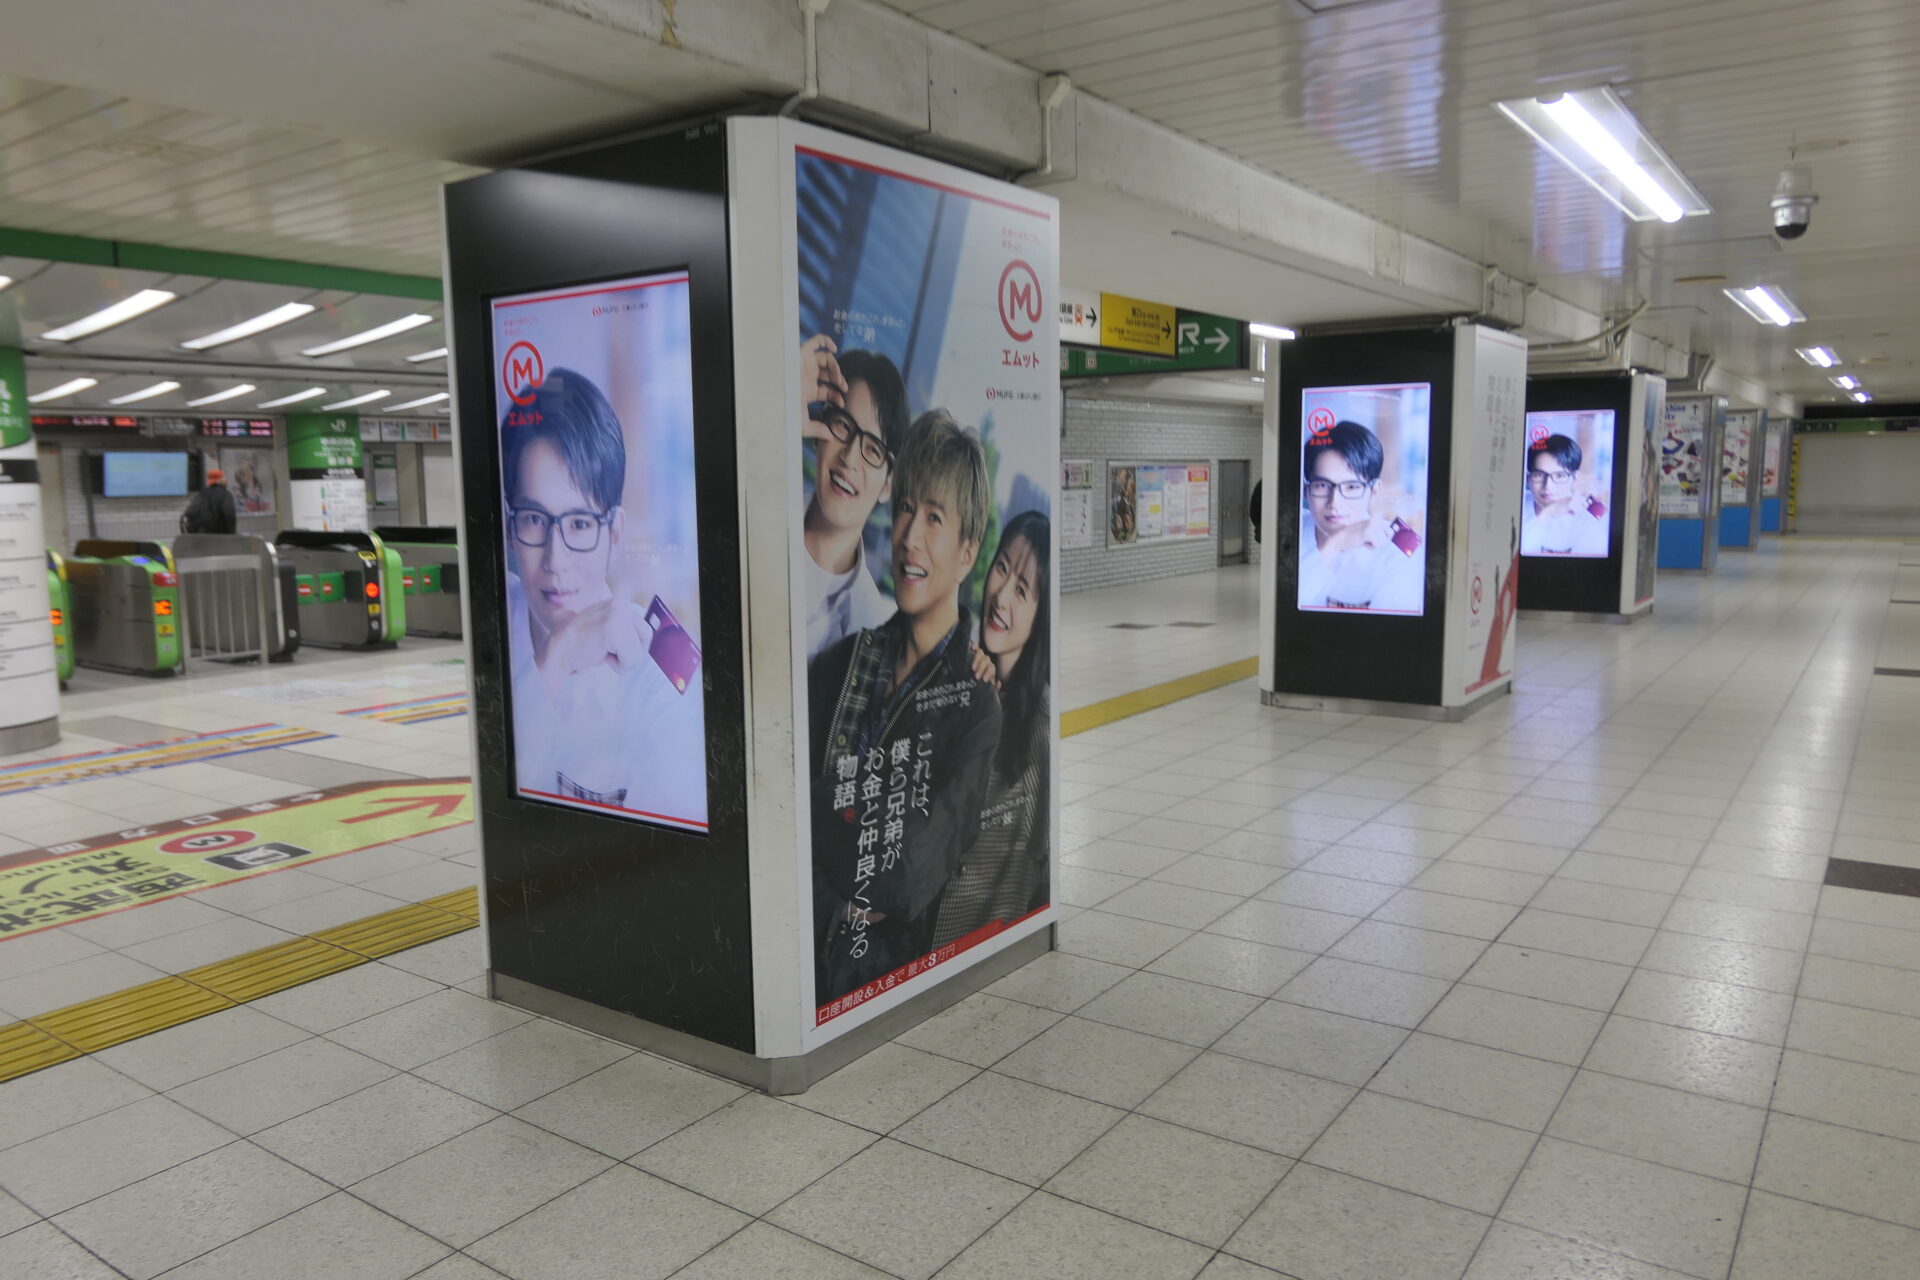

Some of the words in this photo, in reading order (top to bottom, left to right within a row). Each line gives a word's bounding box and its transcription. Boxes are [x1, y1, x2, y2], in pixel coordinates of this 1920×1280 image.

[1002, 349, 1040, 369] エムット
[507, 411, 544, 426] エムット
[833, 753, 859, 811] 物語
[911, 731, 933, 817] これは、
[881, 736, 911, 872] 僕ら兄弟が
[188, 835, 226, 847] M
[850, 747, 885, 959] お金と仲良くなる
[0, 856, 152, 899] 丸ノ
[818, 968, 905, 1023] 口座開設&入金で
[907, 943, 956, 977] 最大3万円
